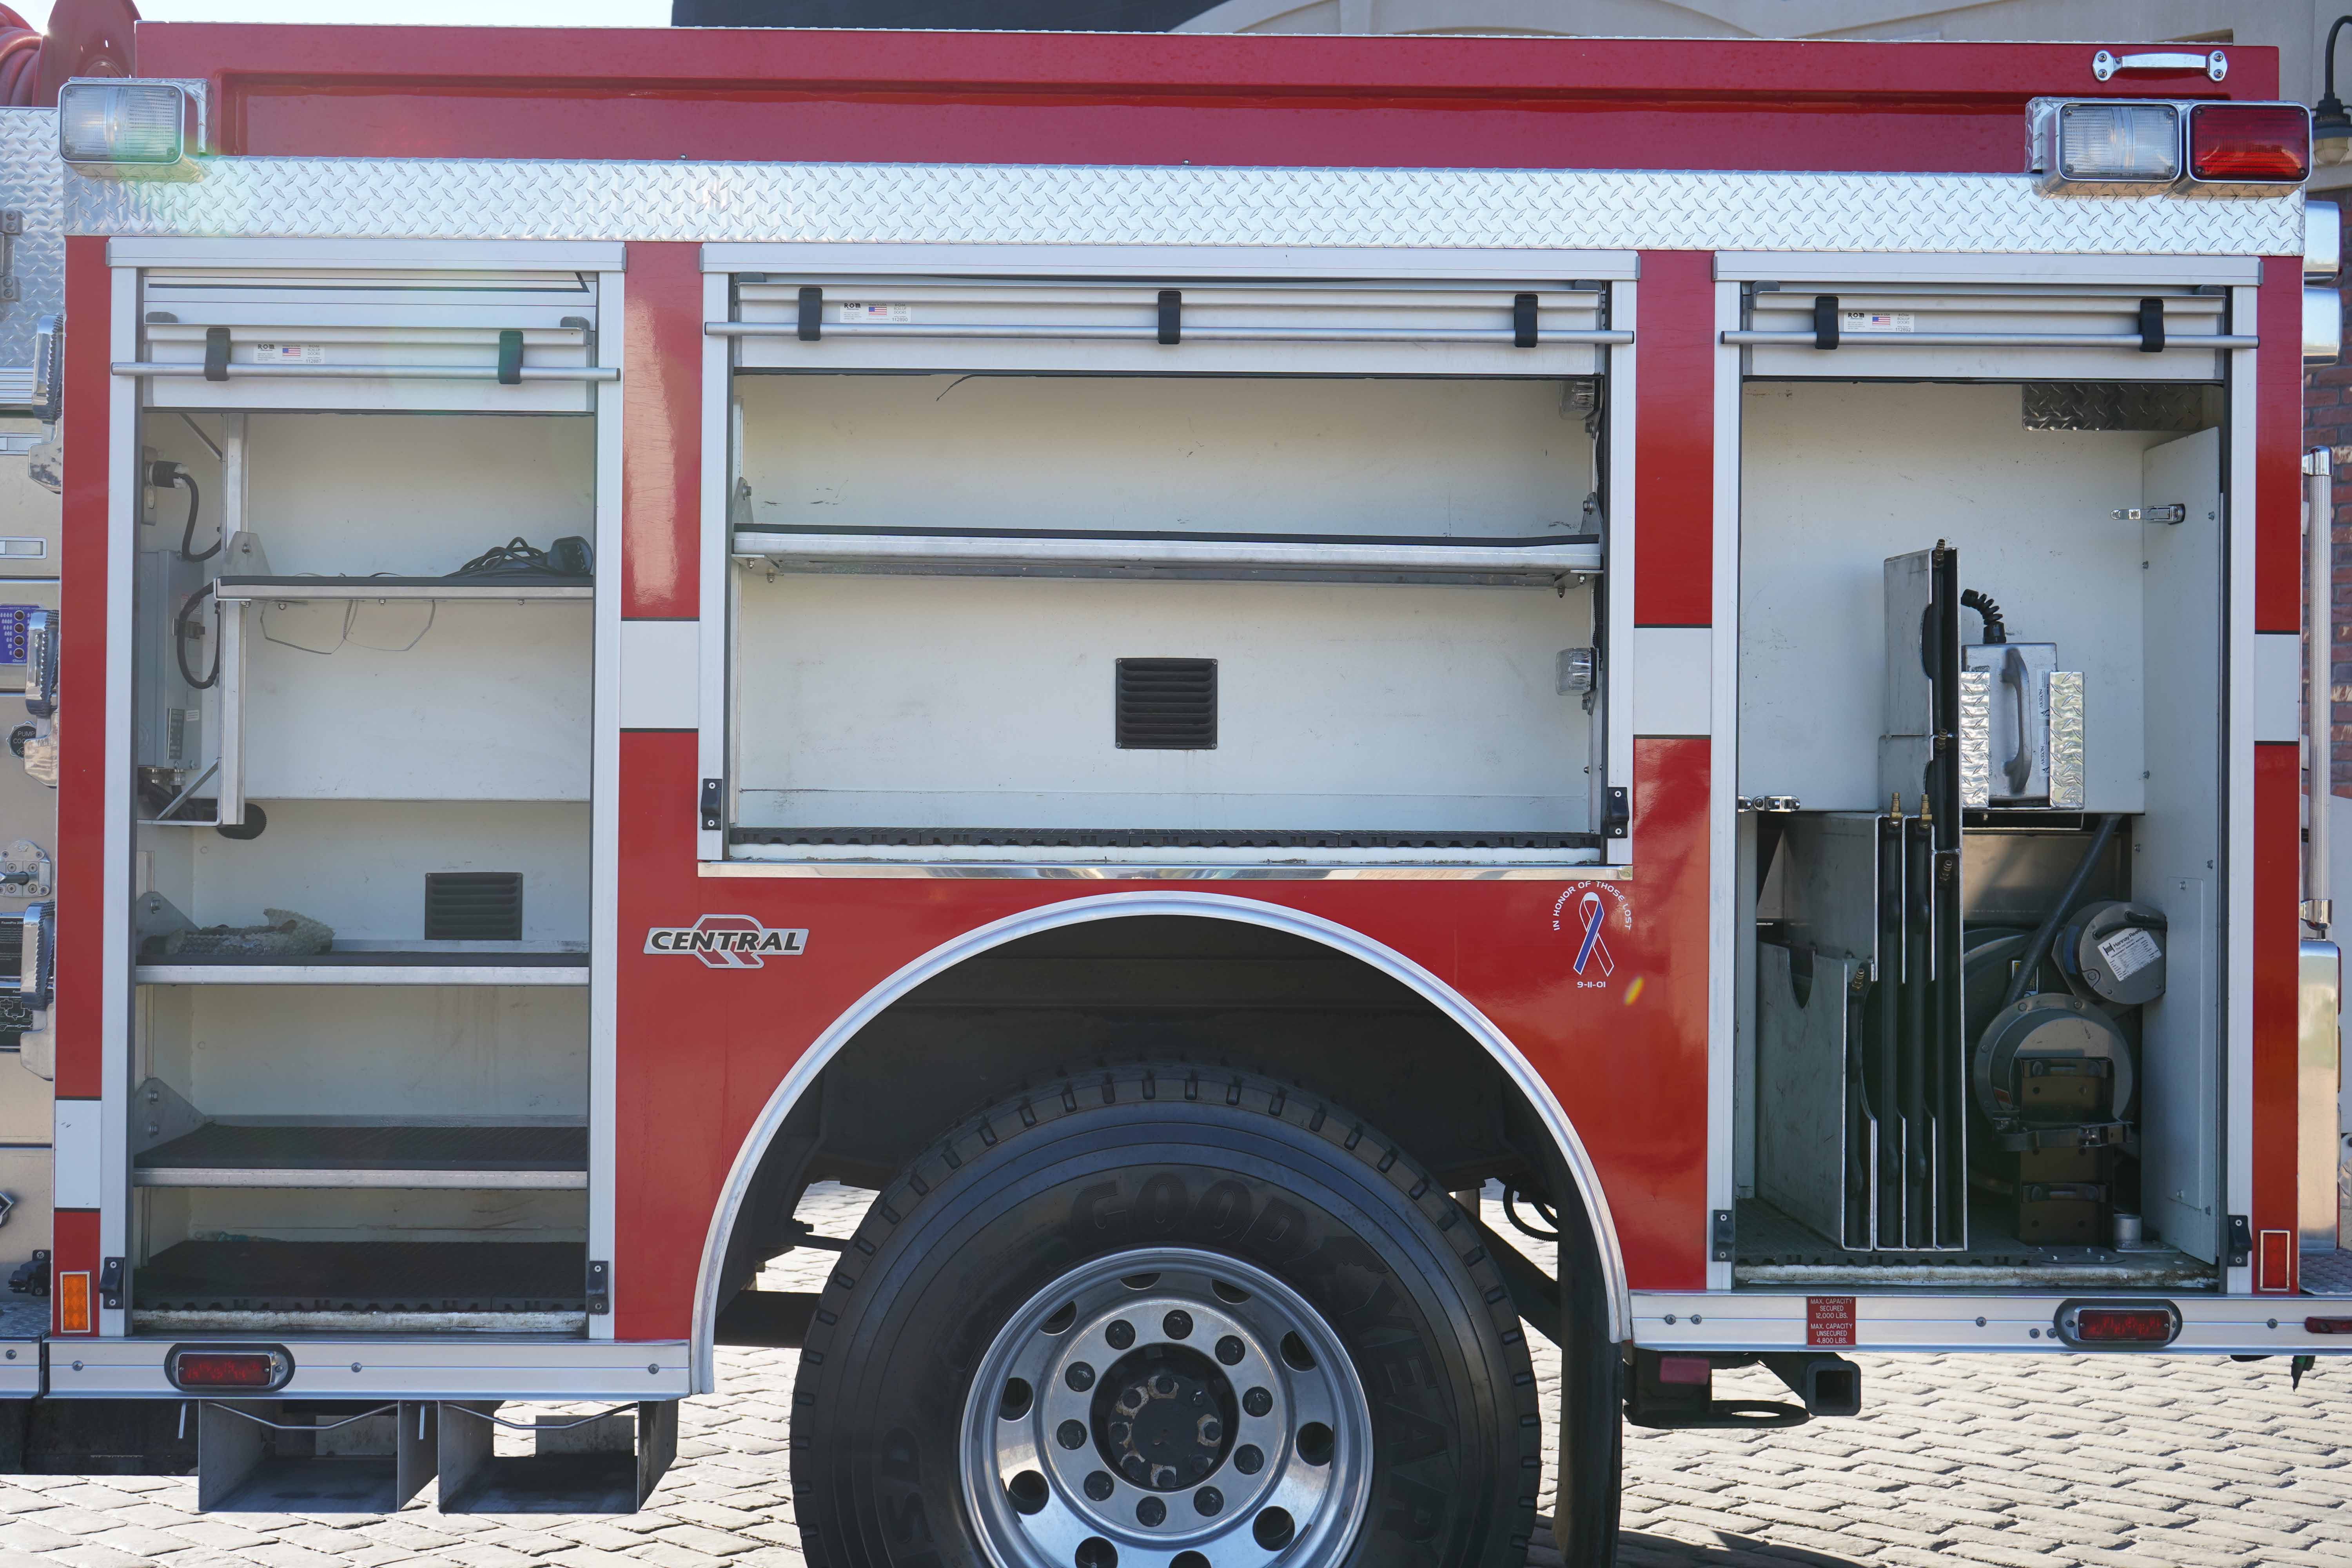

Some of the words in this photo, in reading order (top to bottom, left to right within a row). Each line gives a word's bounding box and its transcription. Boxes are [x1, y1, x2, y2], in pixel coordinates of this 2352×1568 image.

[1578, 880, 1591, 889] OF
[1595, 881, 1625, 902] THOSE
[1553, 886, 1576, 916] HONOR
[1552, 920, 1560, 931] IN
[1623, 903, 1632, 930] LOST
[651, 931, 797, 951] CENTRAL
[2113, 935, 2130, 948] Hannay
